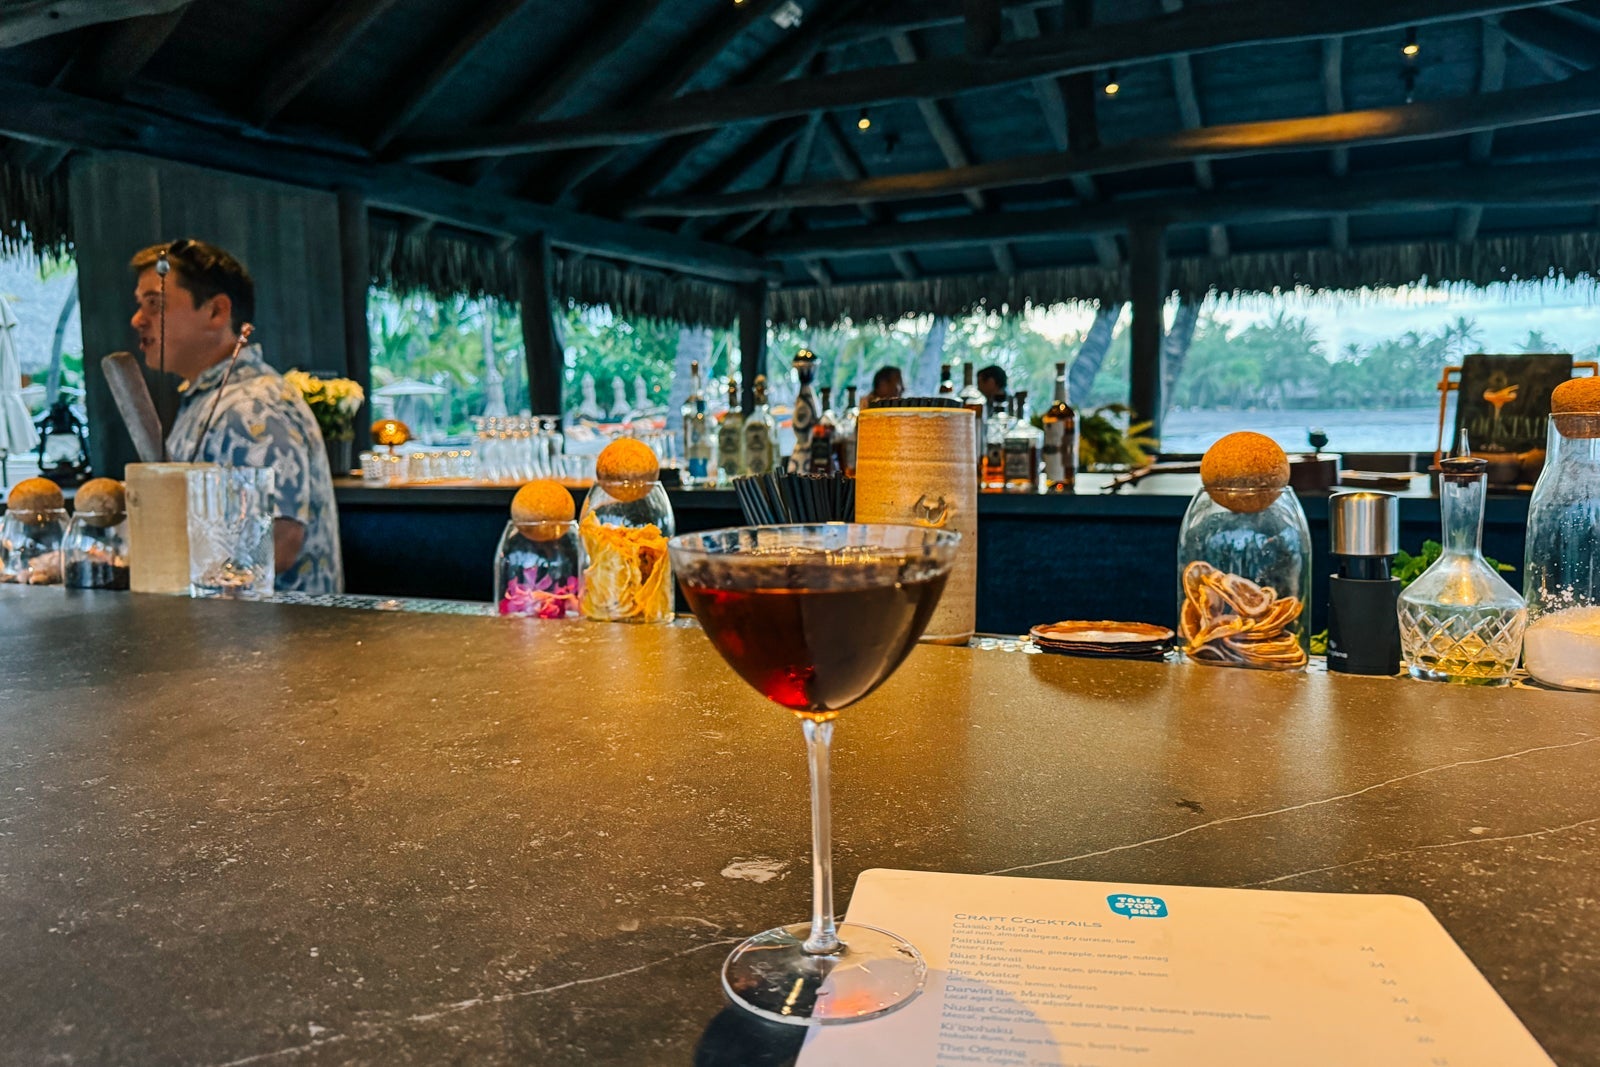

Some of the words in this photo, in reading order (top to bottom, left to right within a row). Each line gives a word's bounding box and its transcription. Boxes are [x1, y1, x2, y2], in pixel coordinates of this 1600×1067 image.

[1114, 902, 1162, 910] STORY
[954, 913, 1007, 923] CRAFT
[1010, 916, 1102, 928] COCKTAILS
[952, 922, 991, 931] Classic
[994, 924, 1016, 933] Mai
[951, 936, 1006, 946] Painkiller
[949, 951, 976, 960] Blue
[980, 954, 1022, 963] Hawaii
[947, 967, 972, 976] The
[975, 970, 1021, 979] Aviator
[945, 984, 992, 995] Darwin
[995, 988, 1017, 997] the
[1020, 990, 1074, 1000] Monkey
[943, 1003, 986, 1013] Nudist
[989, 1006, 1036, 1017] Colony
[937, 1042, 965, 1053] The
[968, 1044, 1027, 1058] Offering
